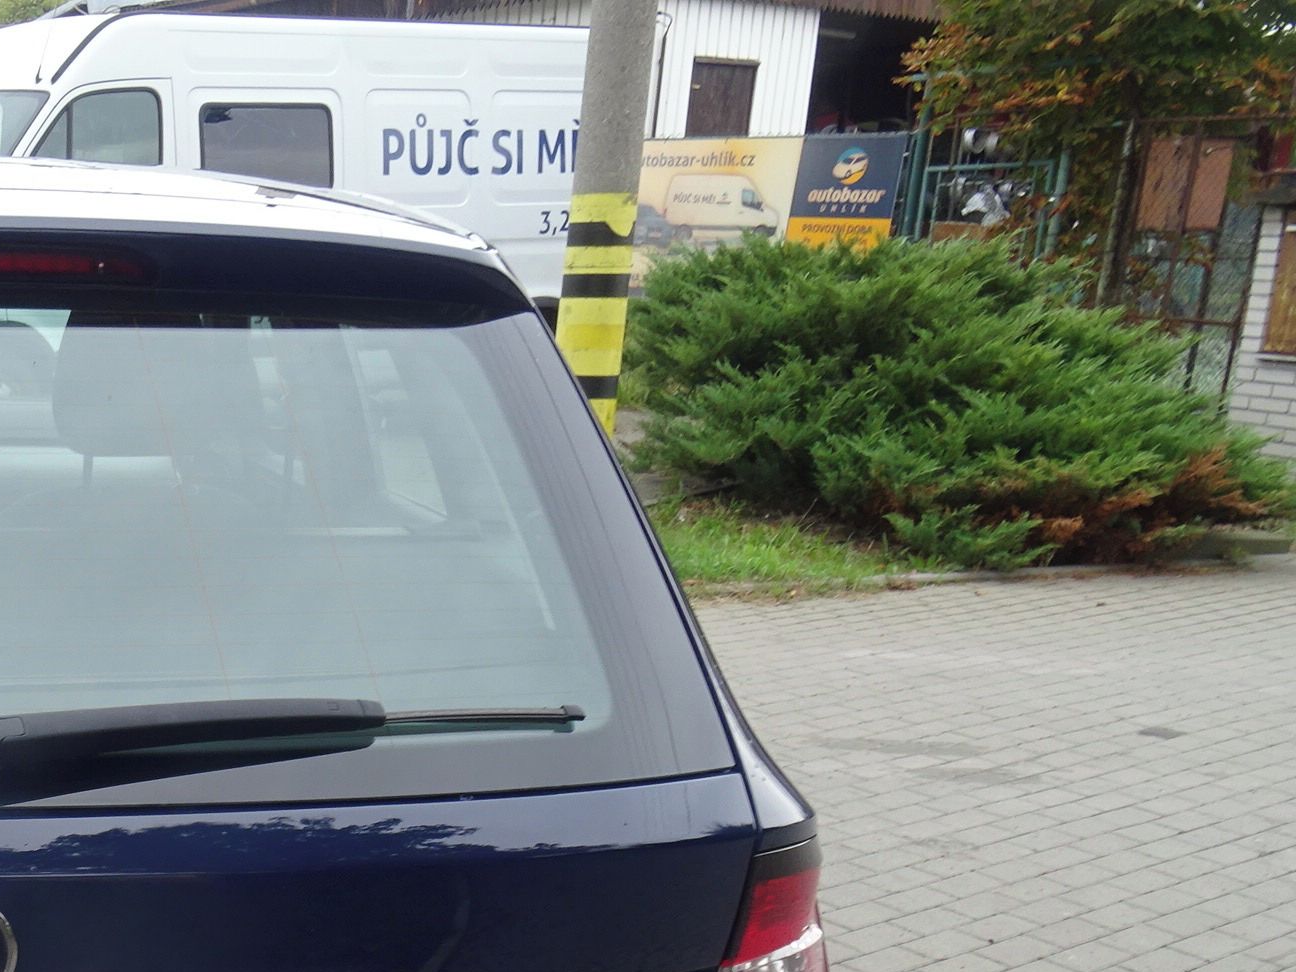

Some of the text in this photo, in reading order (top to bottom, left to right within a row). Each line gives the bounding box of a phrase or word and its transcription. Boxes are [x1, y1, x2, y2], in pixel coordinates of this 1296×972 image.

[382, 113, 479, 176] PŮJČ
[491, 129, 524, 175] SI
[807, 186, 886, 204] autobazar
